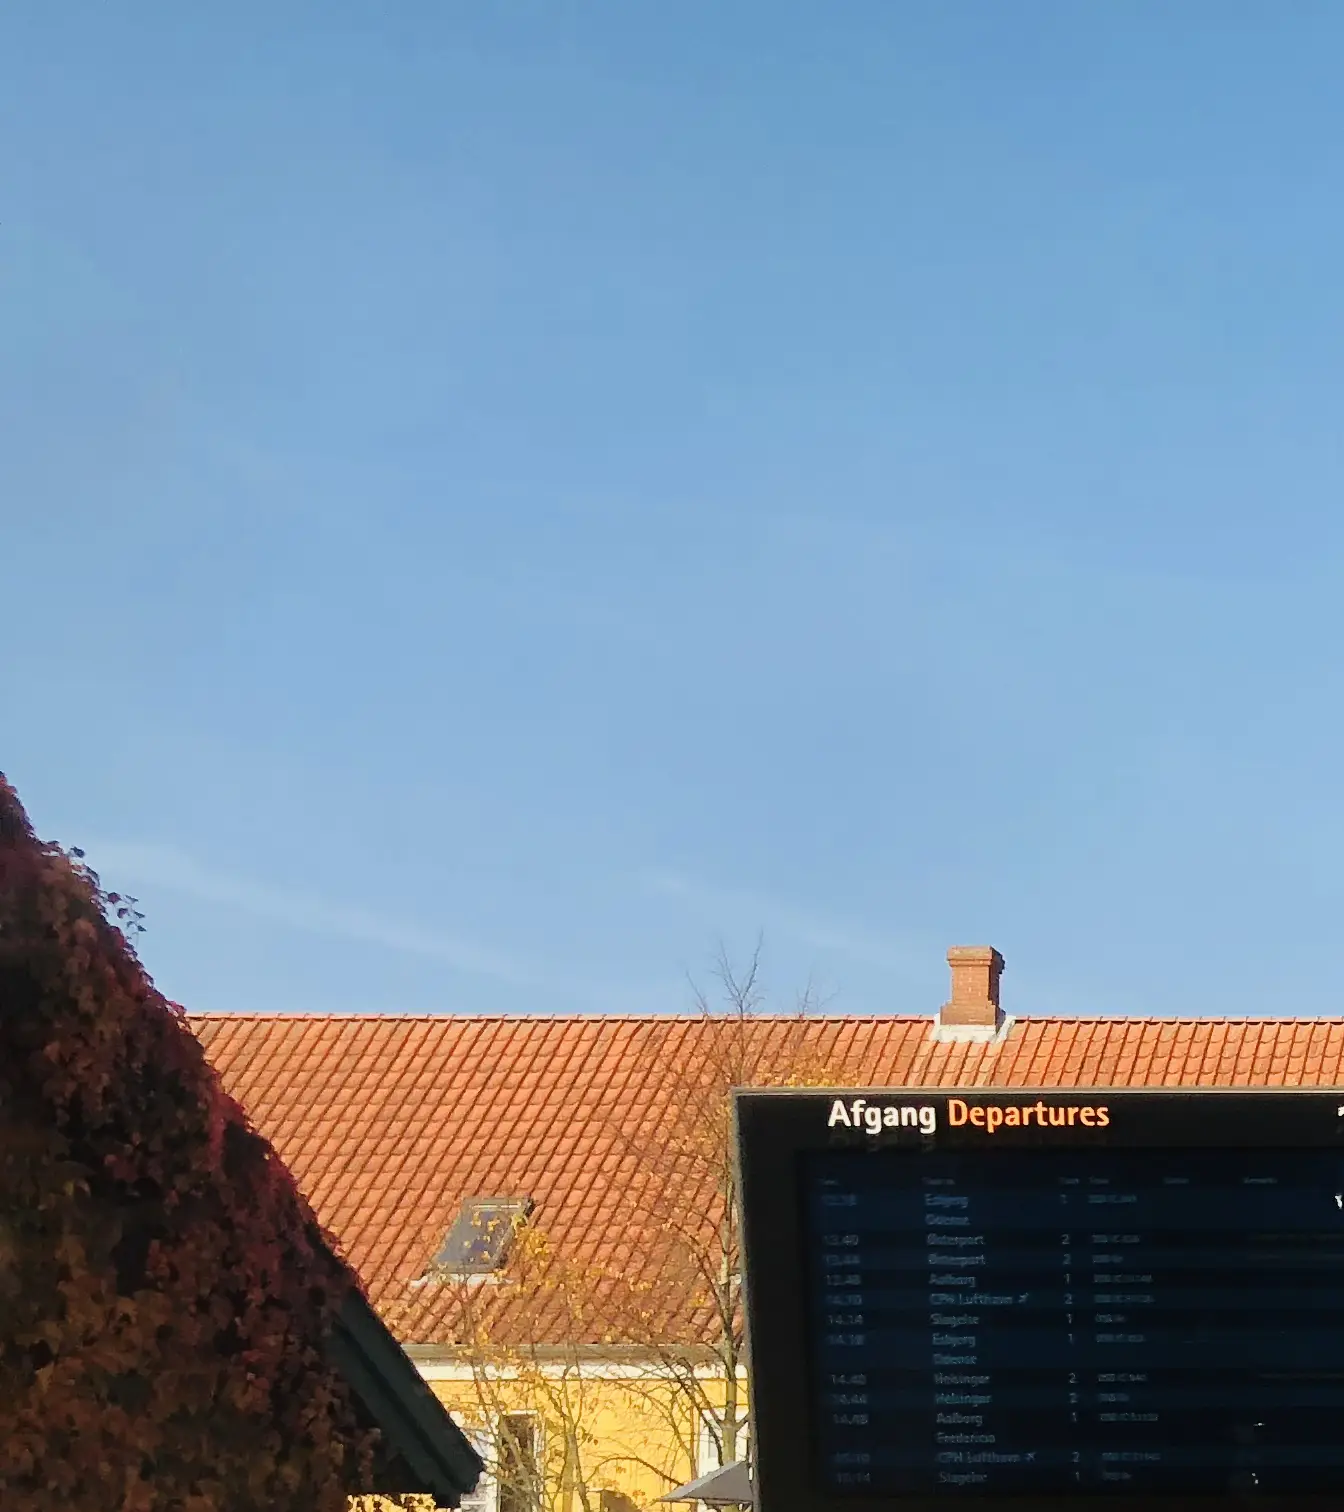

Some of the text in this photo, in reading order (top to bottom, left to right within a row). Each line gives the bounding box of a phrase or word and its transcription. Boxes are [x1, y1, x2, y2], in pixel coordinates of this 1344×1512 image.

[827, 1099, 1110, 1135] Afgang Departures
[1061, 1234, 1070, 1245] 2
[1064, 1293, 1073, 1305] 2
[1068, 1373, 1078, 1384] 2
[1069, 1392, 1079, 1404] 2
[1071, 1451, 1080, 1463] 2
